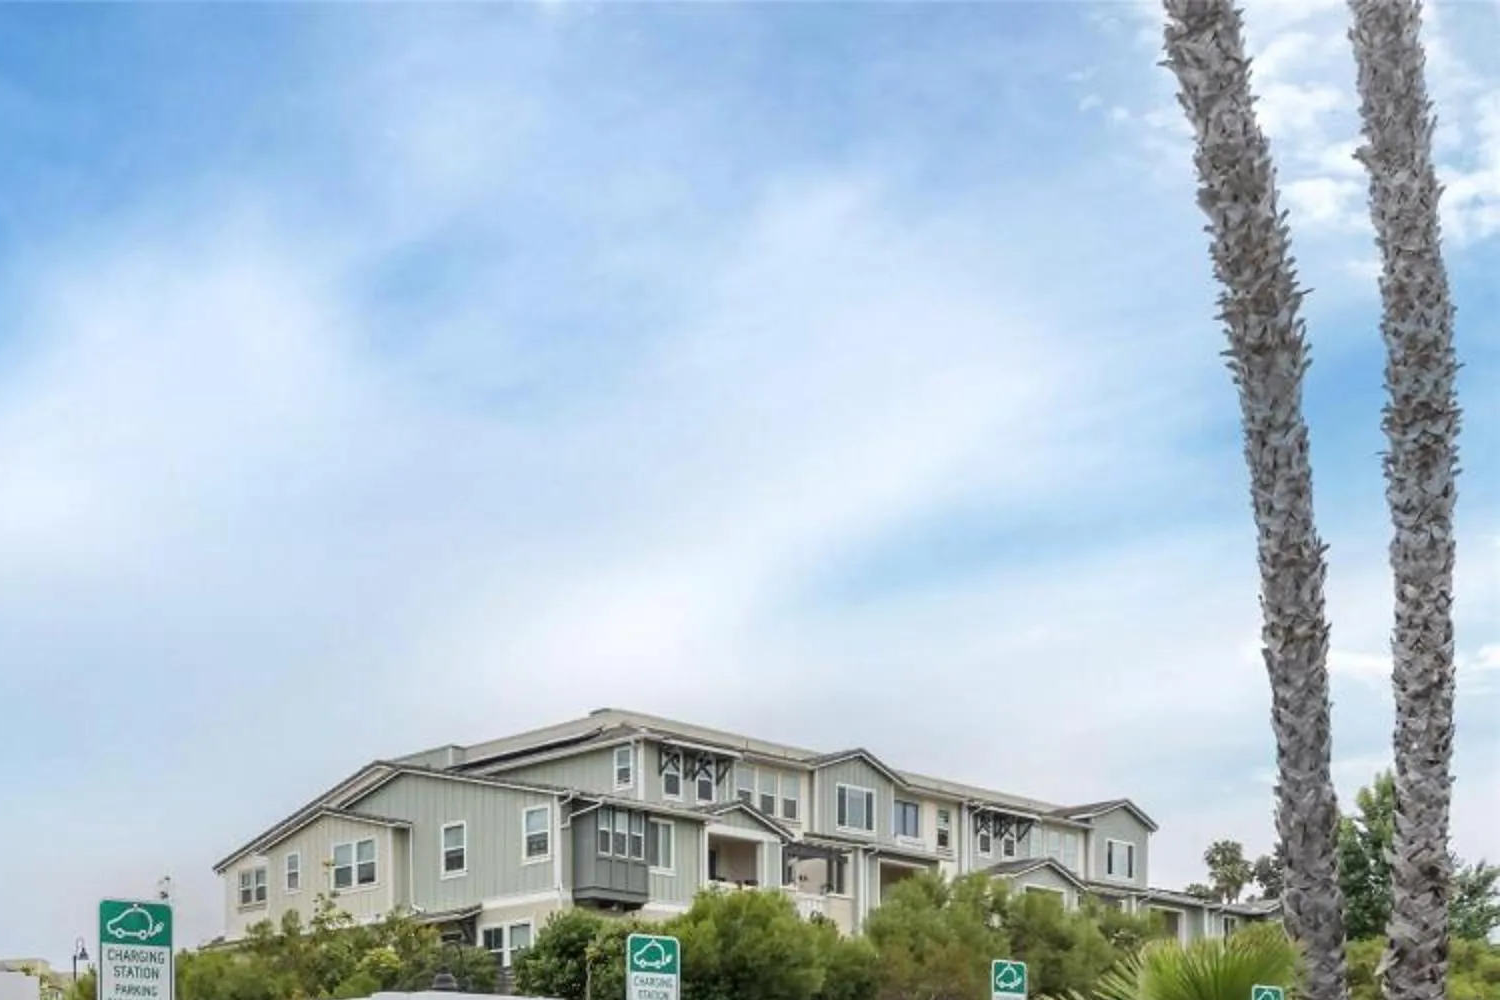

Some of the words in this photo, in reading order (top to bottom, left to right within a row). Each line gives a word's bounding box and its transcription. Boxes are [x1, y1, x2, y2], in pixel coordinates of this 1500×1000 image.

[107, 948, 165, 964] CHARGING
[113, 965, 160, 980] STATION
[115, 984, 158, 997] PARKING
